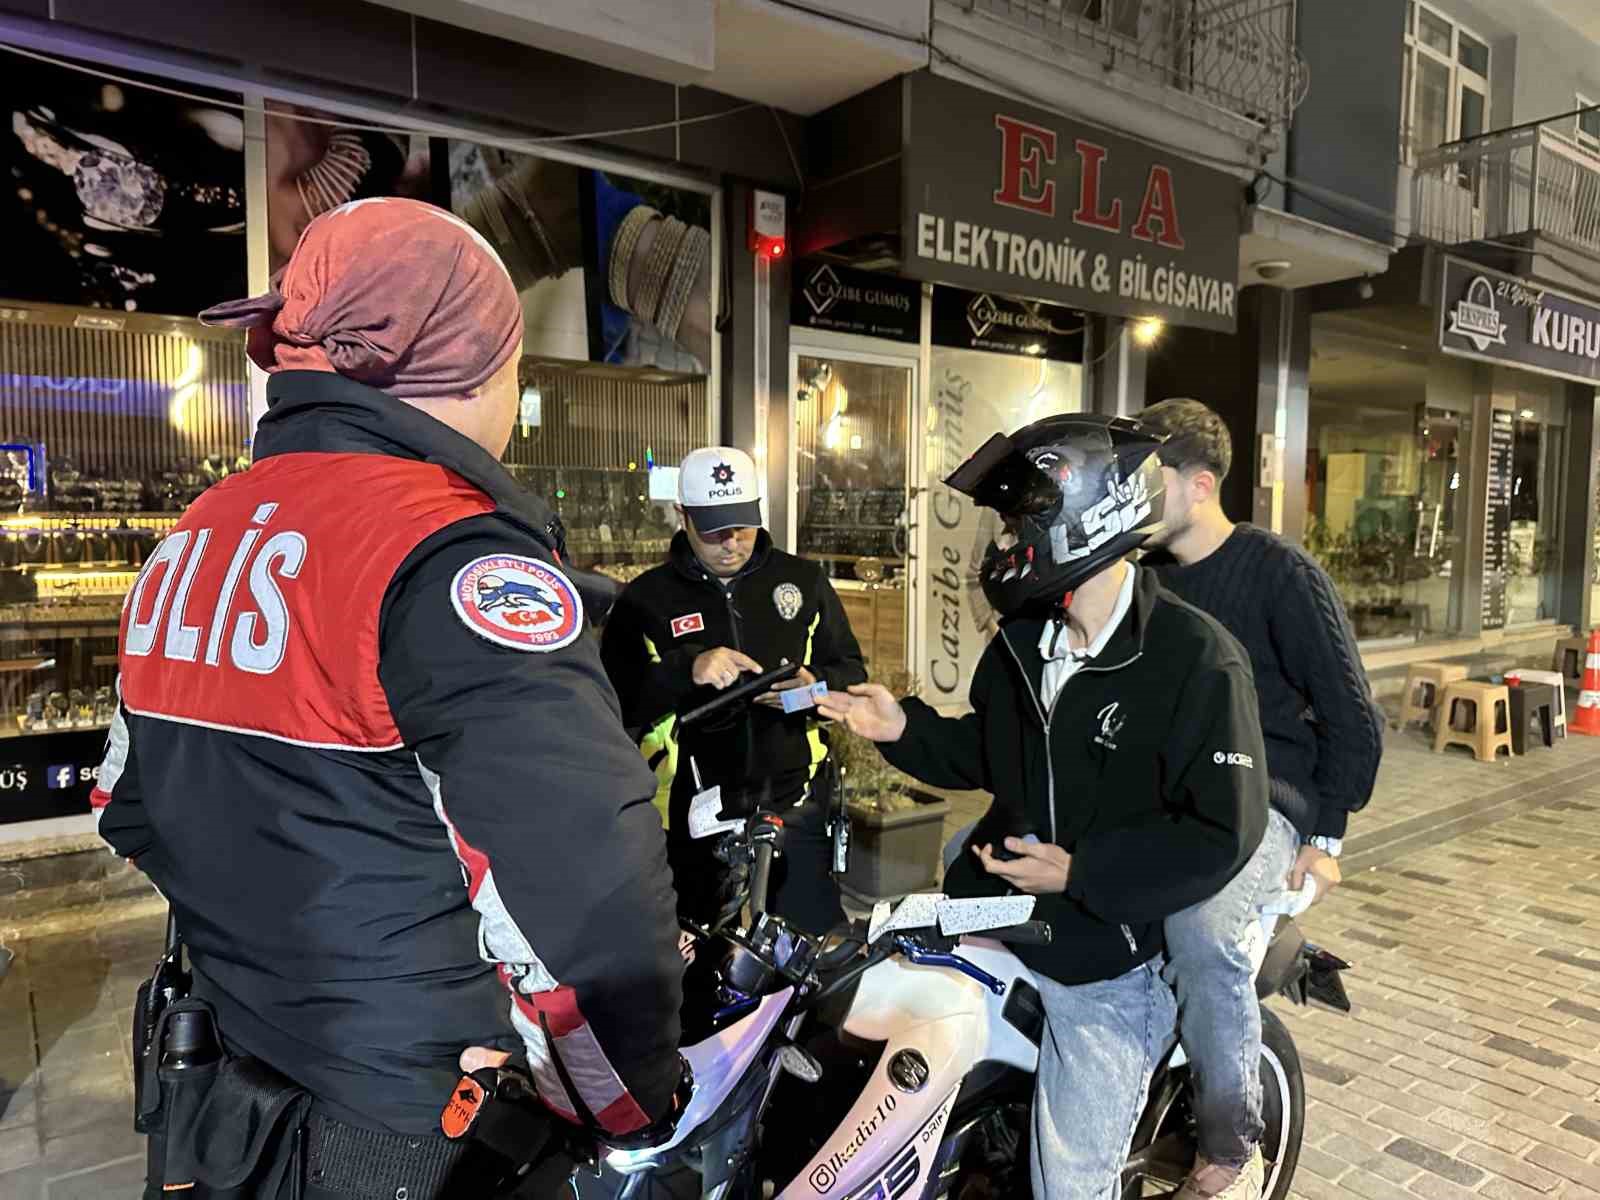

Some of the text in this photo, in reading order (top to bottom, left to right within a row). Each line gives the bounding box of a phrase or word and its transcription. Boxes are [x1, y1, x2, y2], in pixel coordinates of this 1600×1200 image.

[993, 113, 1185, 249] ELA
[917, 213, 1235, 318] ELEKTRONİK & BİLGİSAYAR
[1532, 306, 1600, 359] KURU
[931, 546, 961, 694] Cazibe
[921, 1104, 949, 1143] DRIFT
